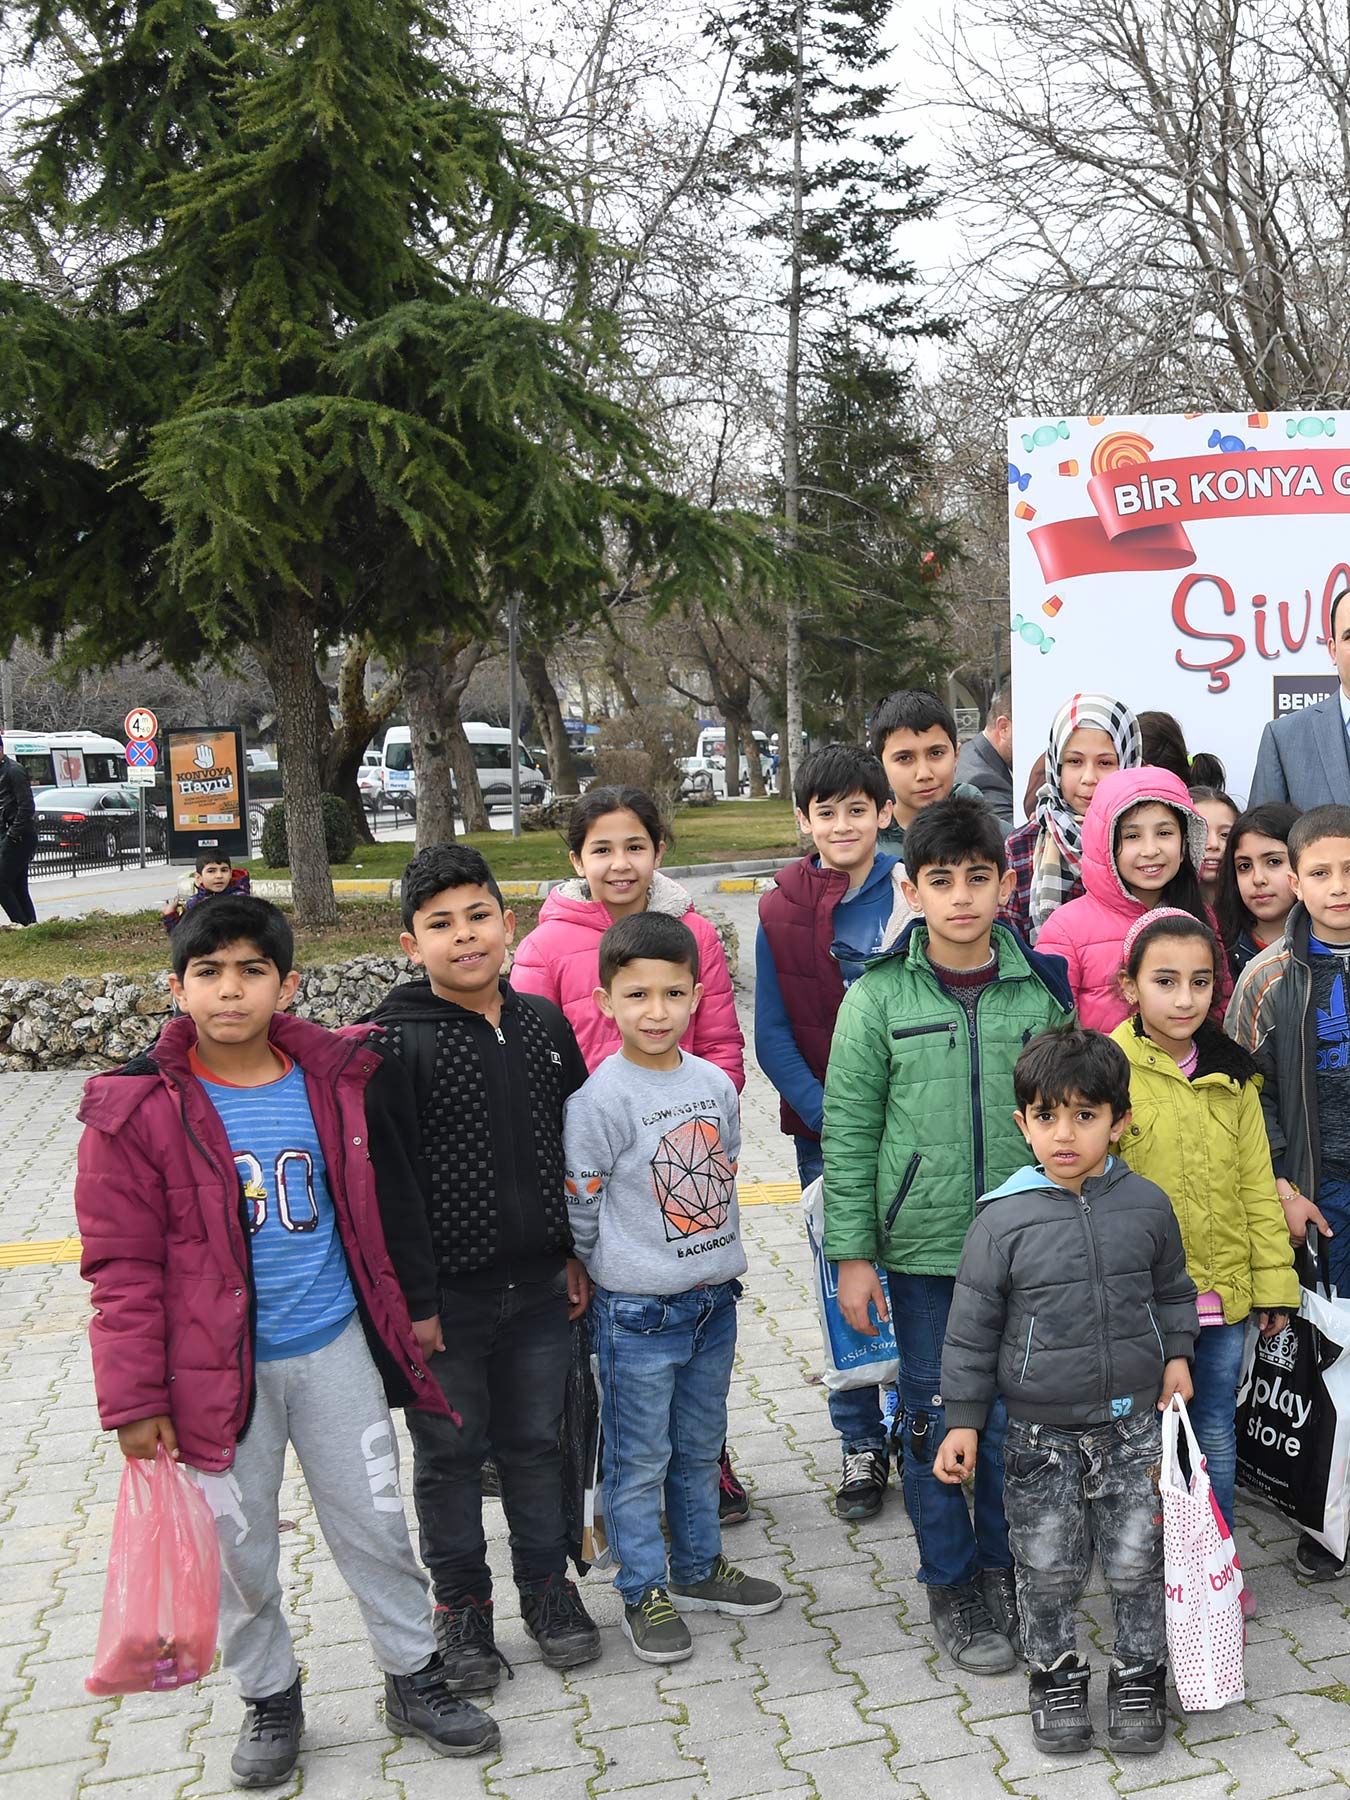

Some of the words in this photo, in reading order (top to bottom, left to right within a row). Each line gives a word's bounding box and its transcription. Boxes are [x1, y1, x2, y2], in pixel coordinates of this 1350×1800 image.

[1114, 474, 1181, 516] BİR
[1189, 465, 1324, 504] KONYA
[176, 766, 232, 782] KONVOYA
[1111, 1398, 1132, 1417] 52
[1251, 1376, 1312, 1428] play
[1246, 1416, 1301, 1457] store
